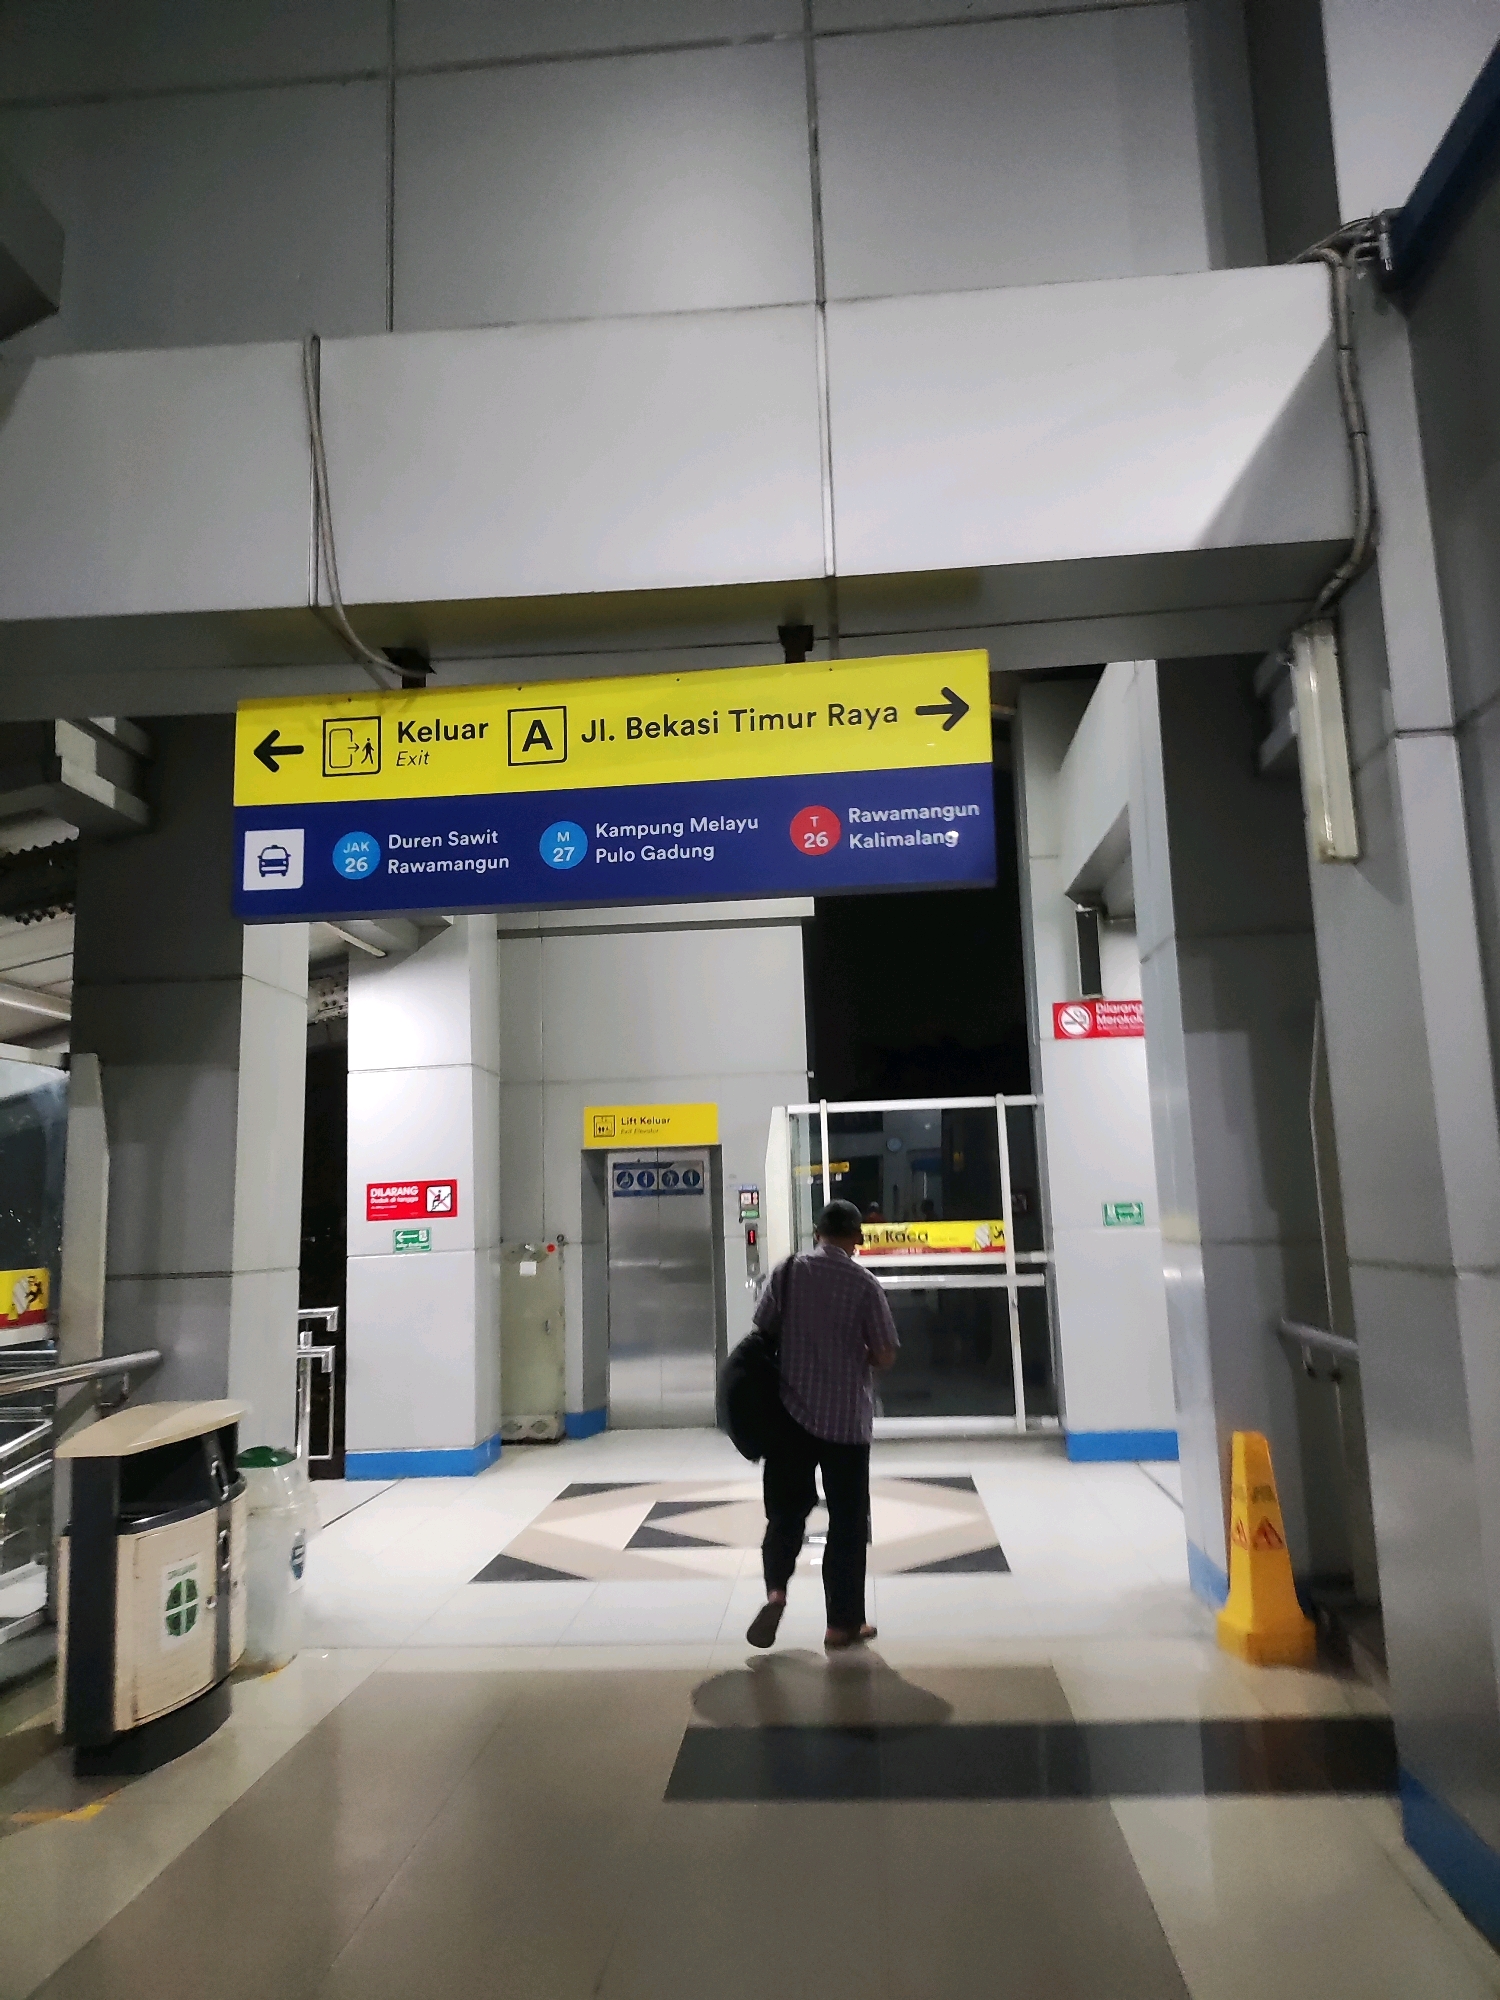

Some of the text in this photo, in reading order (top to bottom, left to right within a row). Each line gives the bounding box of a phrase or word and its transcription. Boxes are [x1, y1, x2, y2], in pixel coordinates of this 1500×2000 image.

[396, 719, 490, 744] Keluar
[581, 703, 898, 744] Jl. Bekasi Timur Raya
[521, 718, 554, 752] A
[395, 750, 430, 767] Exit
[809, 816, 819, 828] T
[848, 803, 981, 824] Rawamangun
[557, 831, 570, 842] M
[595, 815, 759, 841] Kampung Melayu
[343, 841, 371, 854] JAK
[388, 829, 499, 850] Duren Sawit
[803, 832, 829, 849] 26
[849, 830, 959, 850] Kalimalang
[553, 847, 575, 863] 27
[596, 843, 715, 864] Pulo Gadung
[344, 857, 368, 874] 26
[387, 856, 510, 875] Rawamangun
[621, 1115, 671, 1126] Lift Keluar
[370, 1186, 419, 1197] DILARANG
